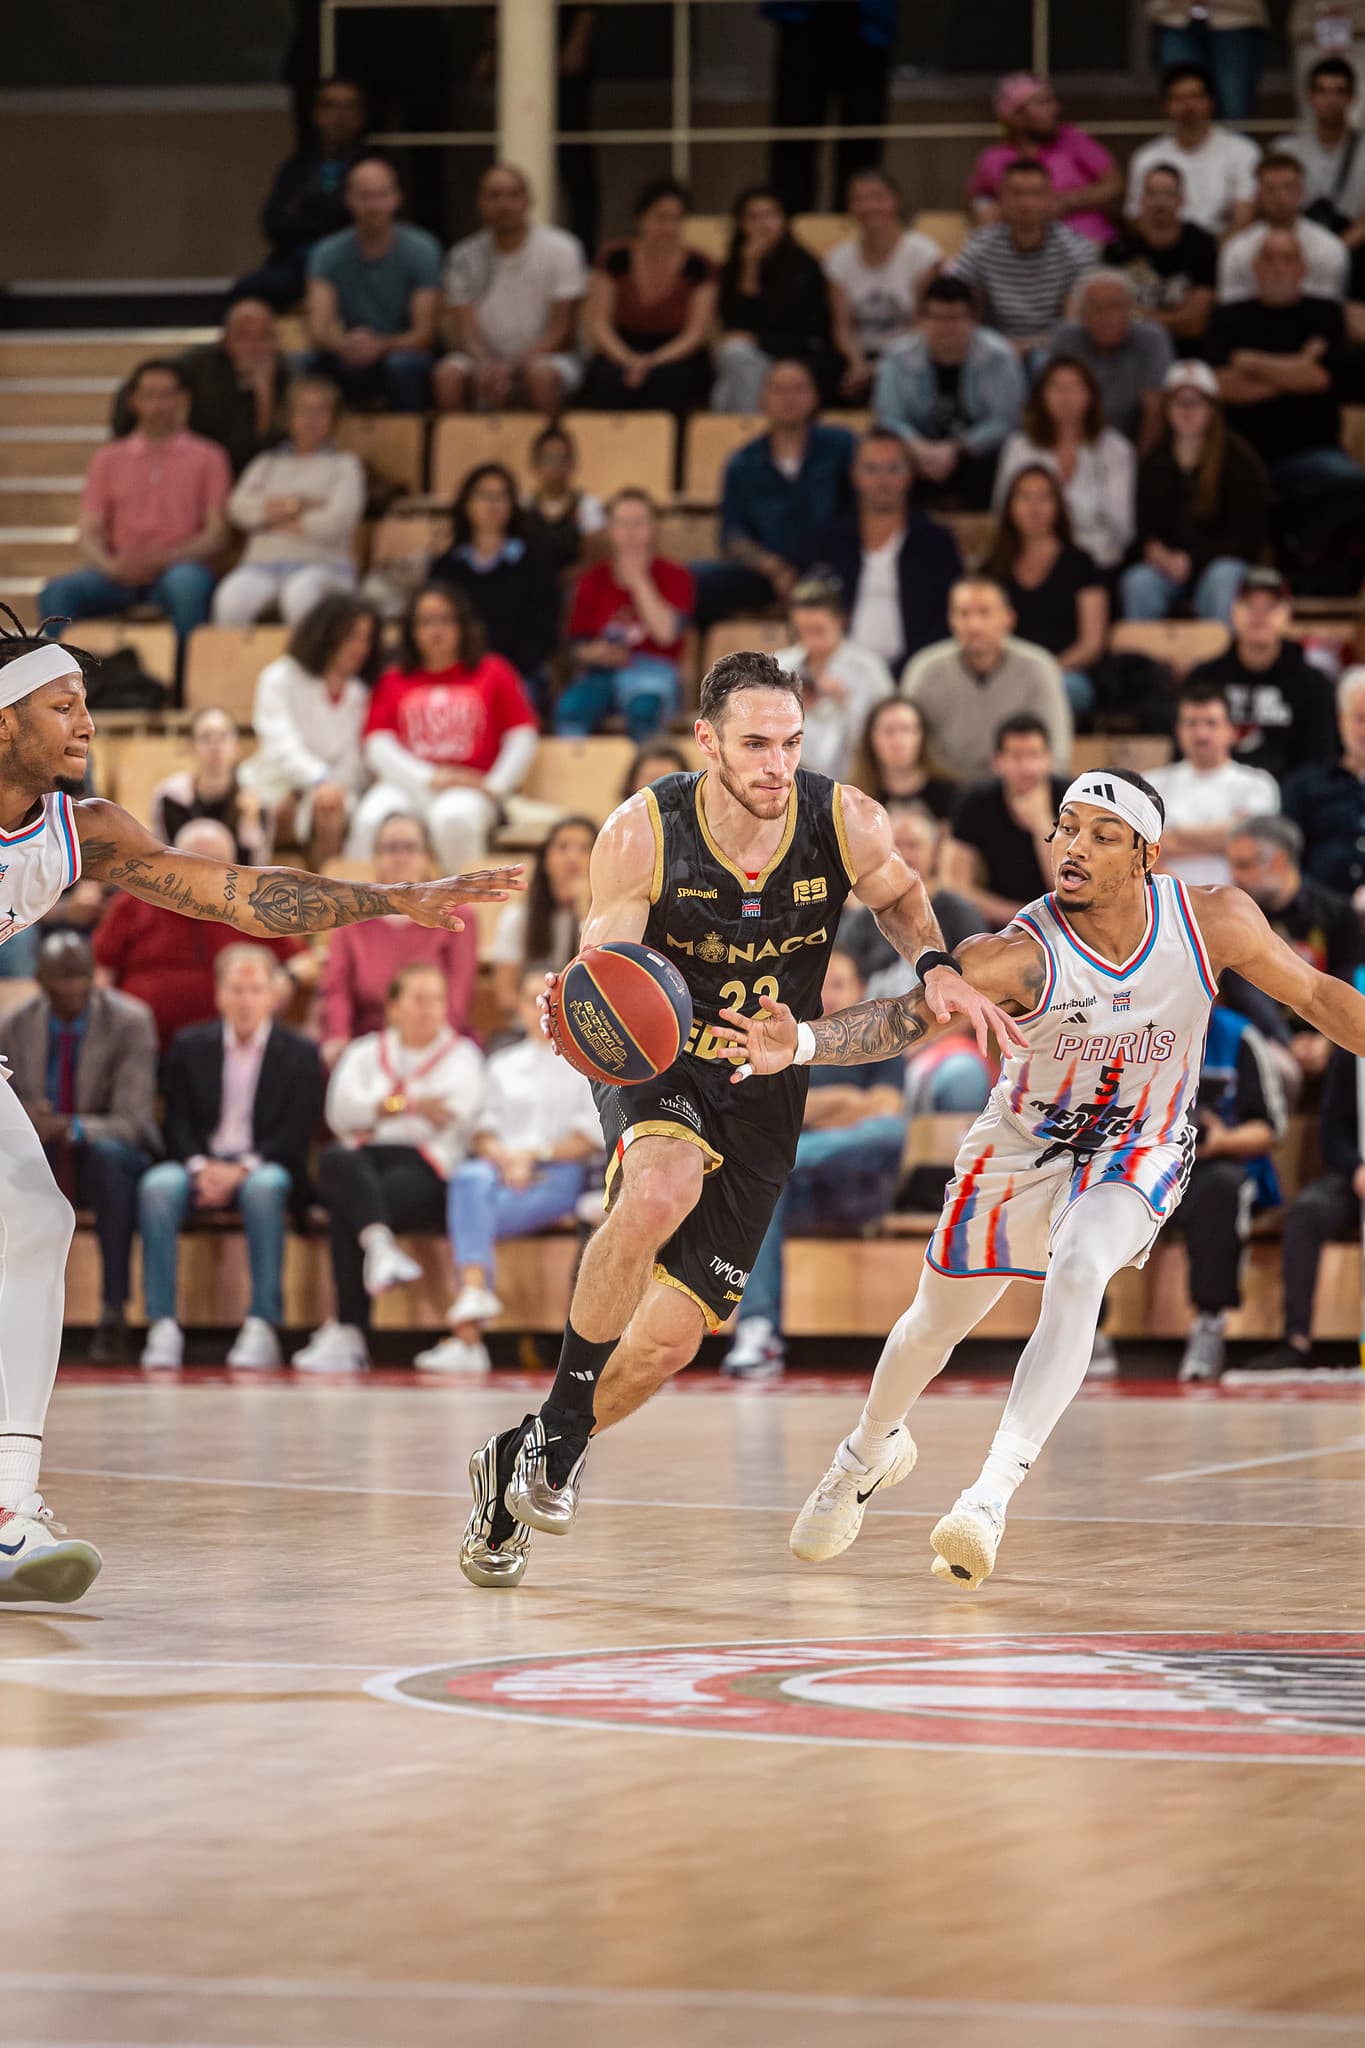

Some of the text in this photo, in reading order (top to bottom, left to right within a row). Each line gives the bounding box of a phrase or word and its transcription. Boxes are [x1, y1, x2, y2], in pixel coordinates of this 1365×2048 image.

[677, 887, 718, 899] SPALDING
[719, 976, 779, 1020] 22
[1050, 995, 1097, 1012] nutribullet
[569, 1000, 625, 1072] LEGACY
[1054, 1030, 1176, 1064] PARIS
[1095, 1065, 1124, 1096] 5
